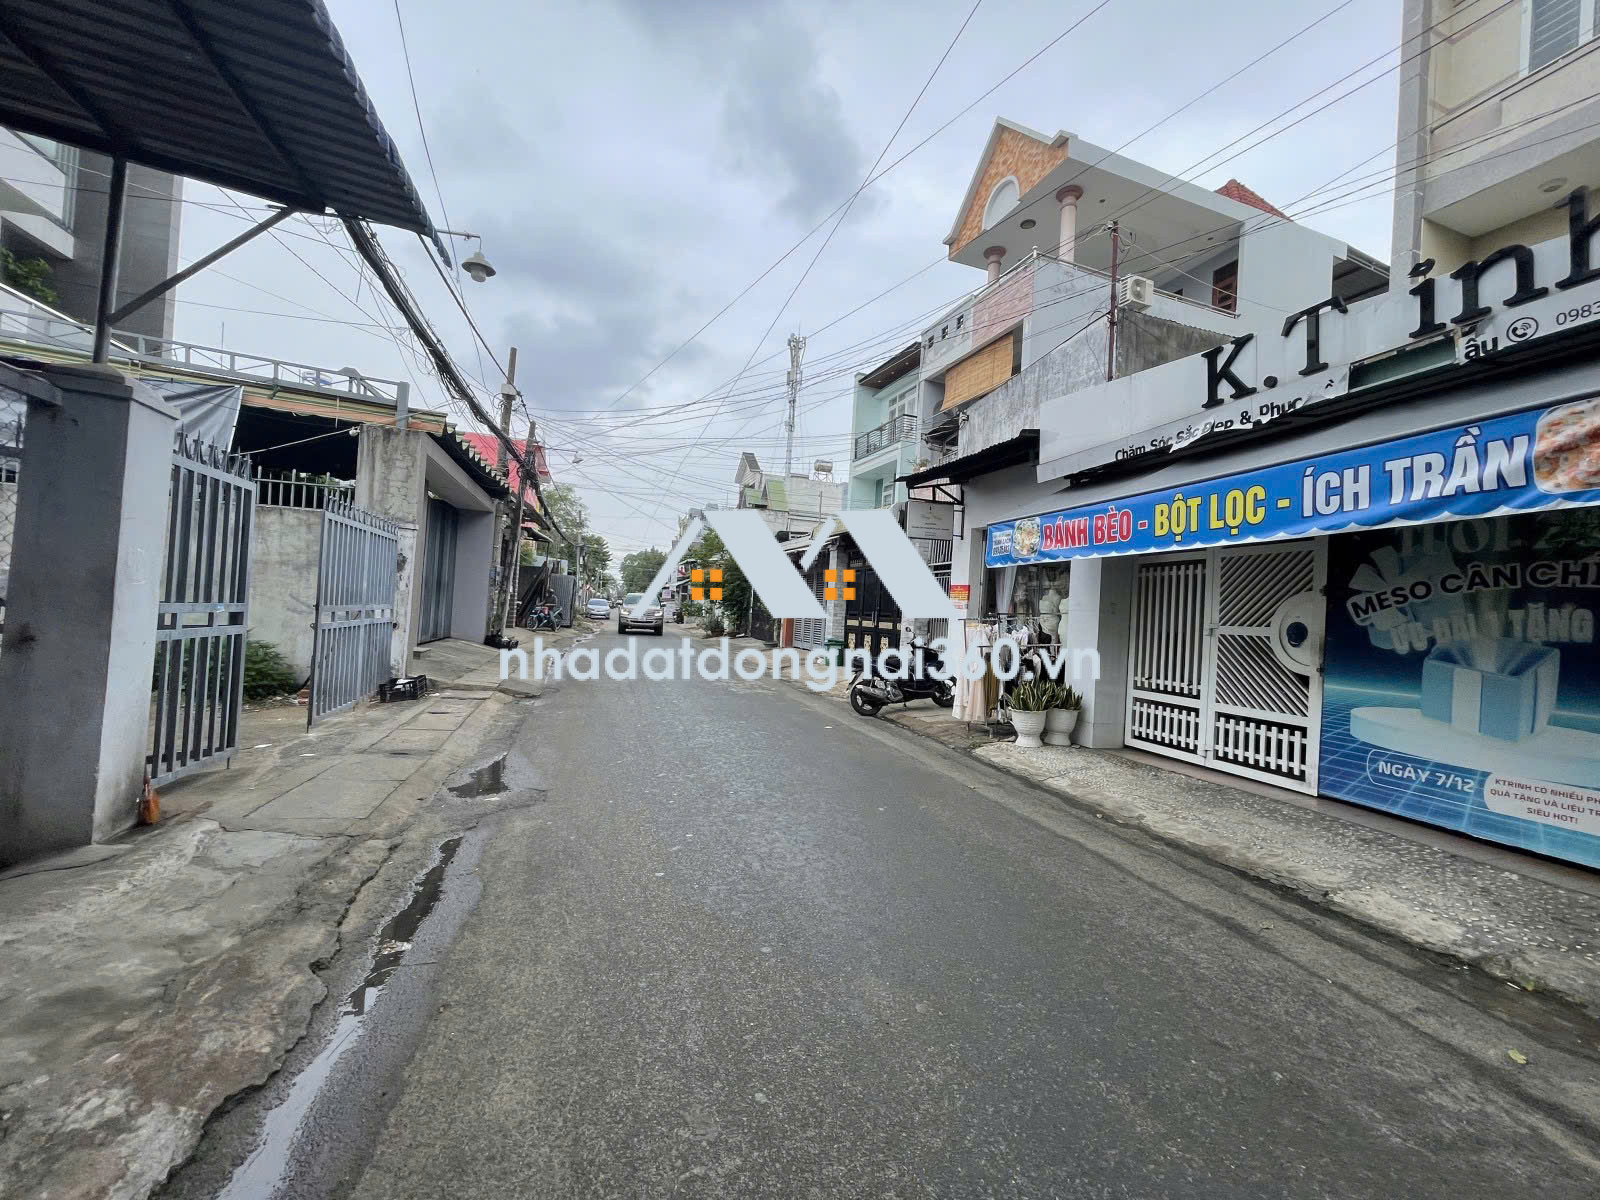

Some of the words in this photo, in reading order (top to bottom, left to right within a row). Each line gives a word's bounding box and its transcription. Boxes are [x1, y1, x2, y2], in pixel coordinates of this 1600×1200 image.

[1239, 410, 1253, 426] &
[1042, 510, 1090, 550] BÁNH
[1092, 507, 1133, 544] BÈO
[1153, 493, 1202, 541] BỘT
[1209, 485, 1266, 536] LỌC
[1302, 465, 1371, 518] ÍCH
[1384, 426, 1529, 505] TRẦN
[1349, 579, 1433, 620] MESO
[1440, 561, 1519, 594] CÂN
[1378, 761, 1431, 783] NGÀY
[1435, 772, 1475, 793] 7/12
